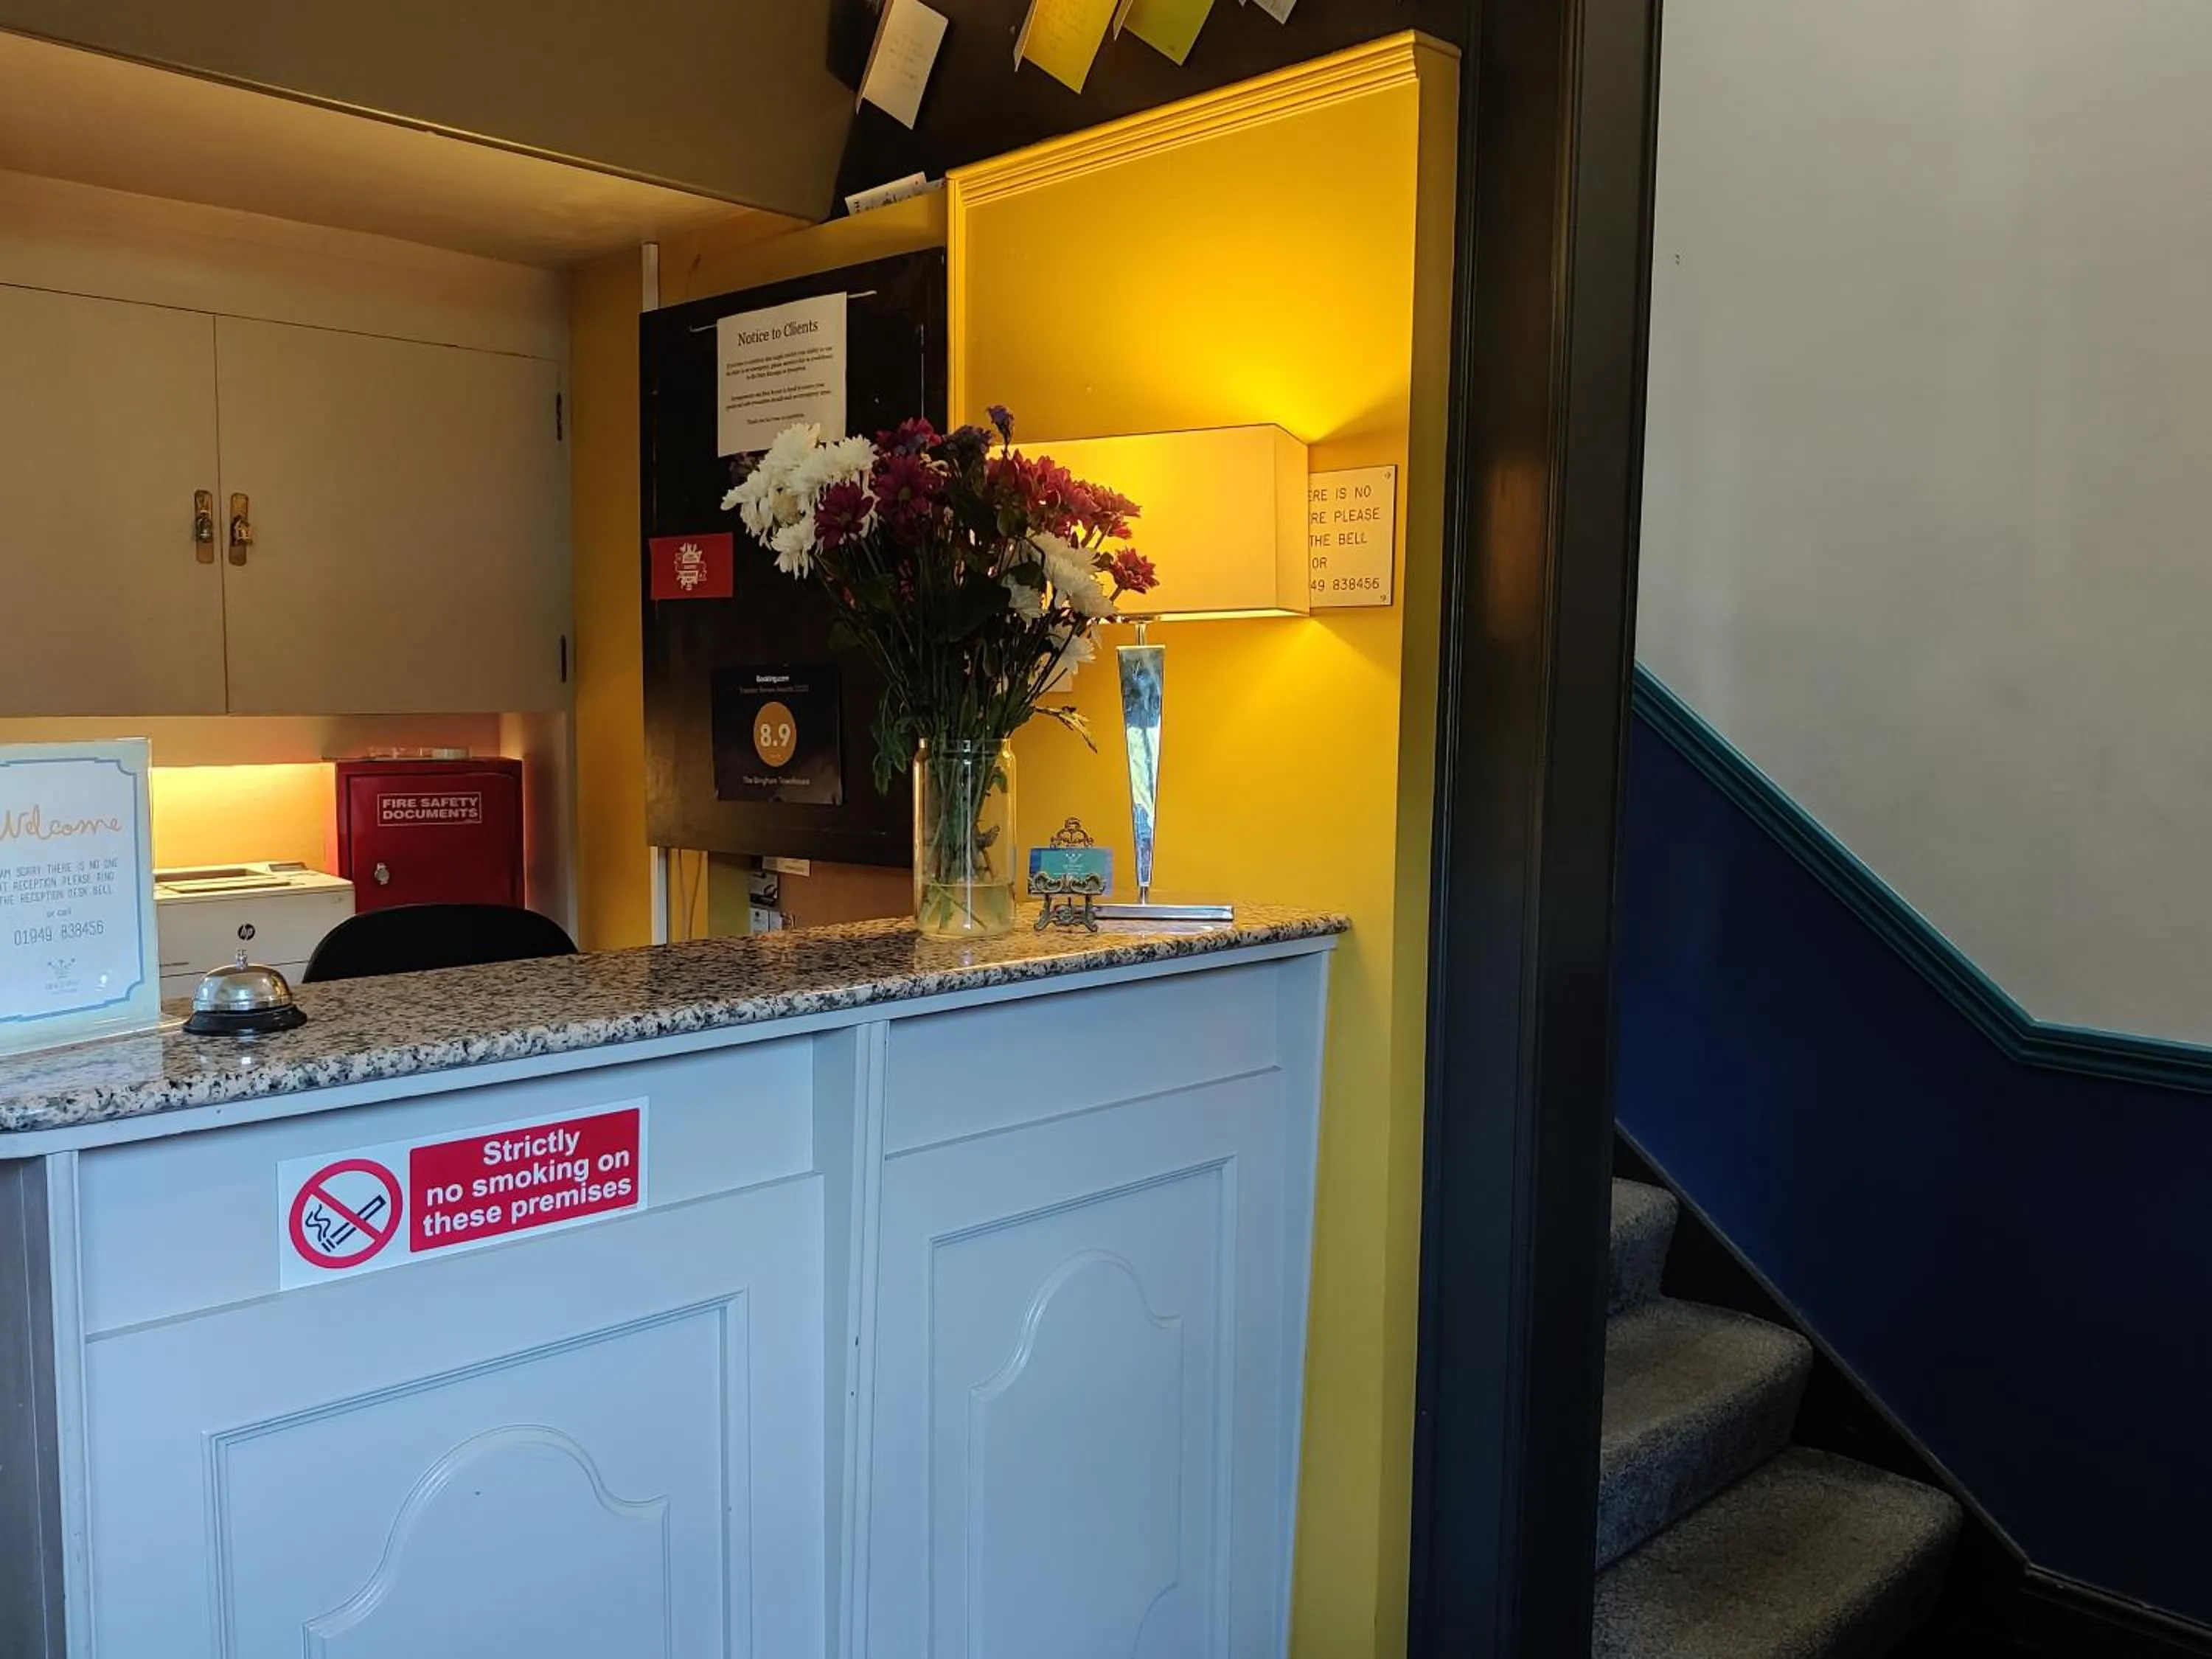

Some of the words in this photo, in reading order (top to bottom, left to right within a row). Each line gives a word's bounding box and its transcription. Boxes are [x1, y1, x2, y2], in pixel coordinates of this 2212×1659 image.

[738, 330, 769, 347] Notice
[772, 327, 782, 340] to
[784, 320, 818, 337] Clients
[1335, 487, 1347, 500] IS
[1354, 485, 1372, 498] NO
[1334, 507, 1381, 523] PLEASE
[1309, 533, 1331, 547] THE
[1338, 532, 1368, 546] BELL
[1312, 557, 1328, 569] OR
[1332, 577, 1380, 591] 838456
[760, 723, 791, 747] 8.9
[383, 799, 417, 809] FIRE
[421, 796, 478, 807] SAFETY
[383, 808, 479, 820] DOCUMENTS
[47, 861, 72, 874] THERE
[104, 858, 118, 869] ONE
[13, 877, 57, 892] RECEPTION
[62, 874, 92, 886] PLEASE
[20, 890, 63, 904] RECEPTION
[67, 886, 88, 898] DESK
[14, 926, 52, 945] 01949
[61, 919, 105, 939] 838456
[238, 923, 256, 942] hp
[483, 1129, 580, 1166] Strictly
[427, 1183, 463, 1206] no
[472, 1158, 589, 1197] smoking
[598, 1150, 630, 1172] on
[422, 1205, 501, 1237] these
[511, 1178, 632, 1224] premises
